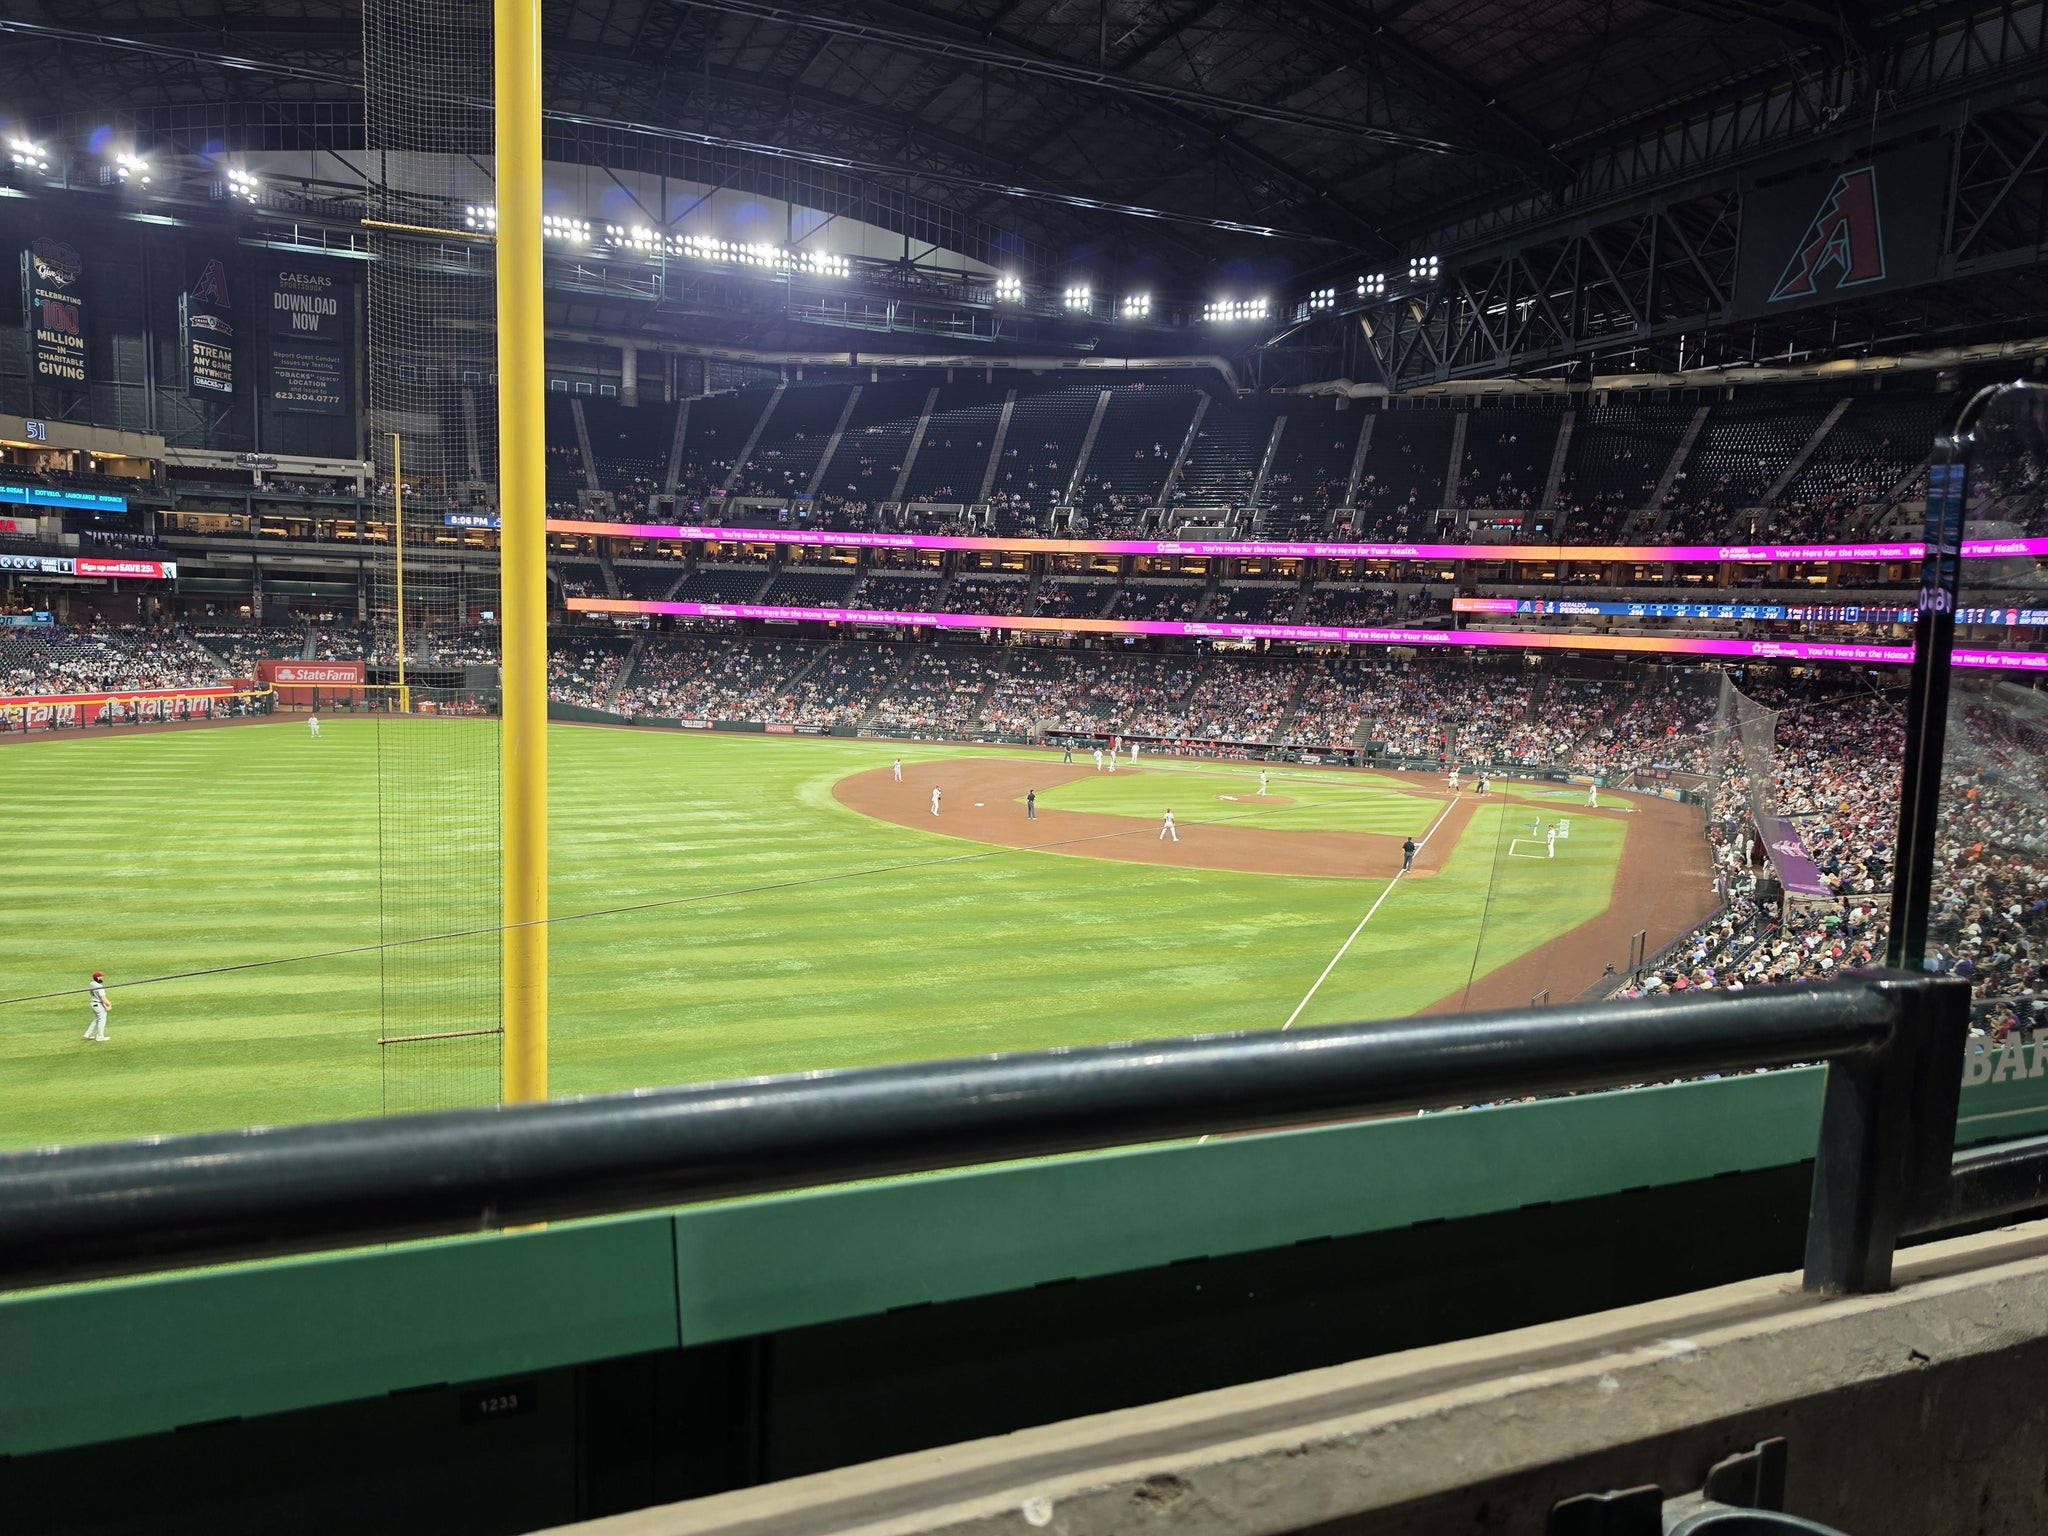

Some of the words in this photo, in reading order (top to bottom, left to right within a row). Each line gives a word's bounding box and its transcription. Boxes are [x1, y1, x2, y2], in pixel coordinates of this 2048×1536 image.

[279, 272, 332, 287] CAESARS
[35, 289, 82, 305] CELEBRATING
[274, 293, 337, 315] DOWNLOAD
[292, 312, 319, 331] NOW
[37, 329, 84, 349] MILLION
[57, 345, 66, 355] IN
[193, 344, 232, 362] STREAM
[38, 352, 84, 367] CHARITABLE
[193, 356, 210, 367] ANY
[211, 360, 232, 372] GAME
[38, 361, 85, 380] GIVING
[193, 366, 232, 381] ANYWHERE
[288, 379, 327, 387] LOCATION
[275, 391, 340, 403] 623.304.0777
[26, 421, 46, 440] 51
[451, 516, 472, 524] 8:06
[473, 517, 488, 525] PM
[758, 532, 768, 540] for
[781, 533, 801, 541] Home
[862, 536, 872, 544] for
[1266, 546, 1287, 554] Home
[1338, 547, 1356, 555] Here
[1357, 547, 1370, 555] for
[1370, 547, 1388, 555] Your
[1775, 549, 1800, 558] You're
[1802, 549, 1822, 557] Here
[1824, 548, 1838, 557] for
[1839, 549, 1852, 557] the
[1853, 549, 1877, 557] Home
[1879, 547, 1904, 556] Team.
[1972, 545, 1994, 554] Your
[120, 563, 140, 572] SAVE
[1559, 602, 1587, 610] GERALDO
[763, 609, 780, 617] Here
[780, 609, 790, 617] for
[790, 610, 801, 618] the
[803, 611, 821, 619] Home
[884, 613, 895, 622] for
[1253, 628, 1271, 636] Here
[1271, 627, 1283, 636] for
[1283, 628, 1296, 637] the
[1296, 629, 1319, 637] Home
[1370, 631, 1388, 639] Here
[1389, 631, 1402, 641] for
[1403, 632, 1422, 641] Your
[1807, 647, 1833, 656] You're
[1835, 649, 1854, 657] Here
[1854, 648, 1868, 658] for
[1868, 649, 1882, 659] the
[1883, 651, 1909, 660] Home
[1963, 655, 1985, 663] Here
[1985, 654, 2000, 664] for
[2001, 656, 2021, 665] Your
[480, 1394, 518, 1413] 1233
